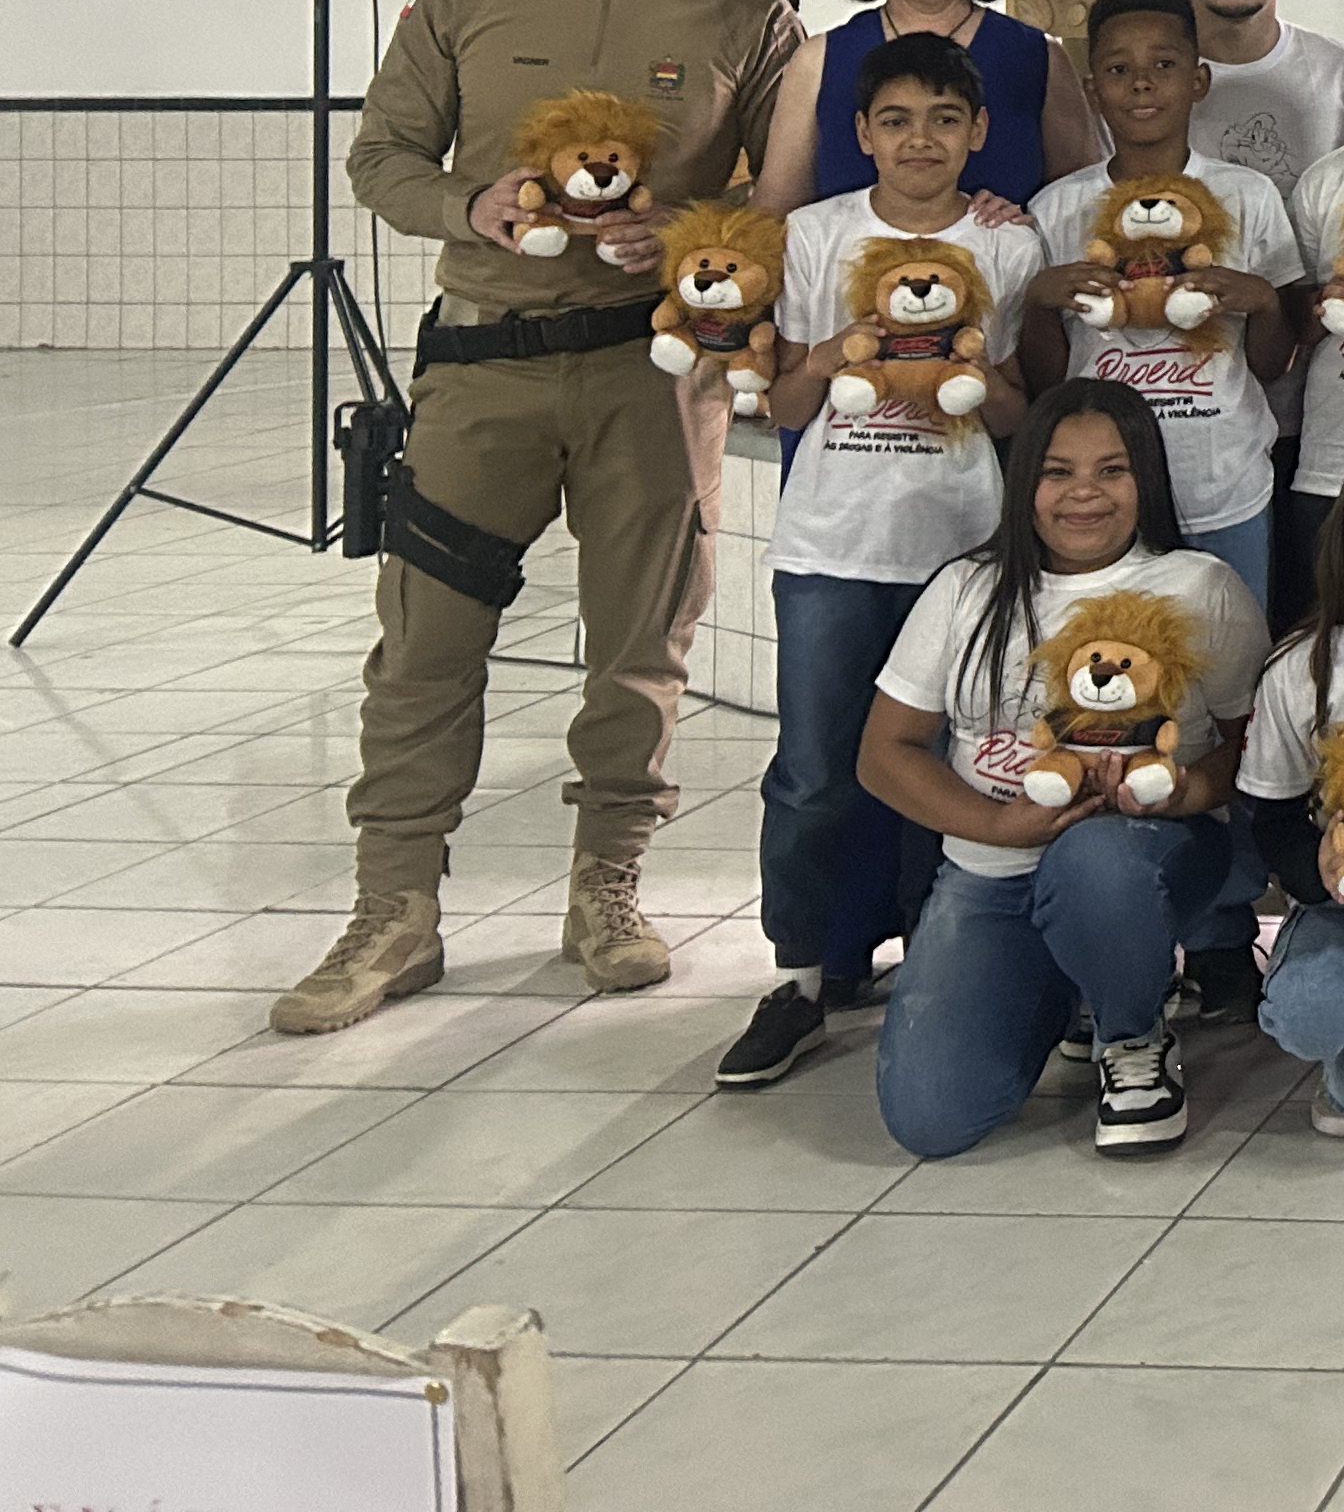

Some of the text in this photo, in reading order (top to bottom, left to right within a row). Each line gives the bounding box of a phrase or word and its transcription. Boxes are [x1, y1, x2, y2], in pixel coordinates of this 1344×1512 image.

[1095, 346, 1214, 386] Proerd
[1168, 406, 1221, 419] VIOLÊNCIA
[848, 430, 872, 440] PARA
[824, 439, 837, 450] ÀS
[875, 443, 882, 452] E
[884, 442, 892, 453] À
